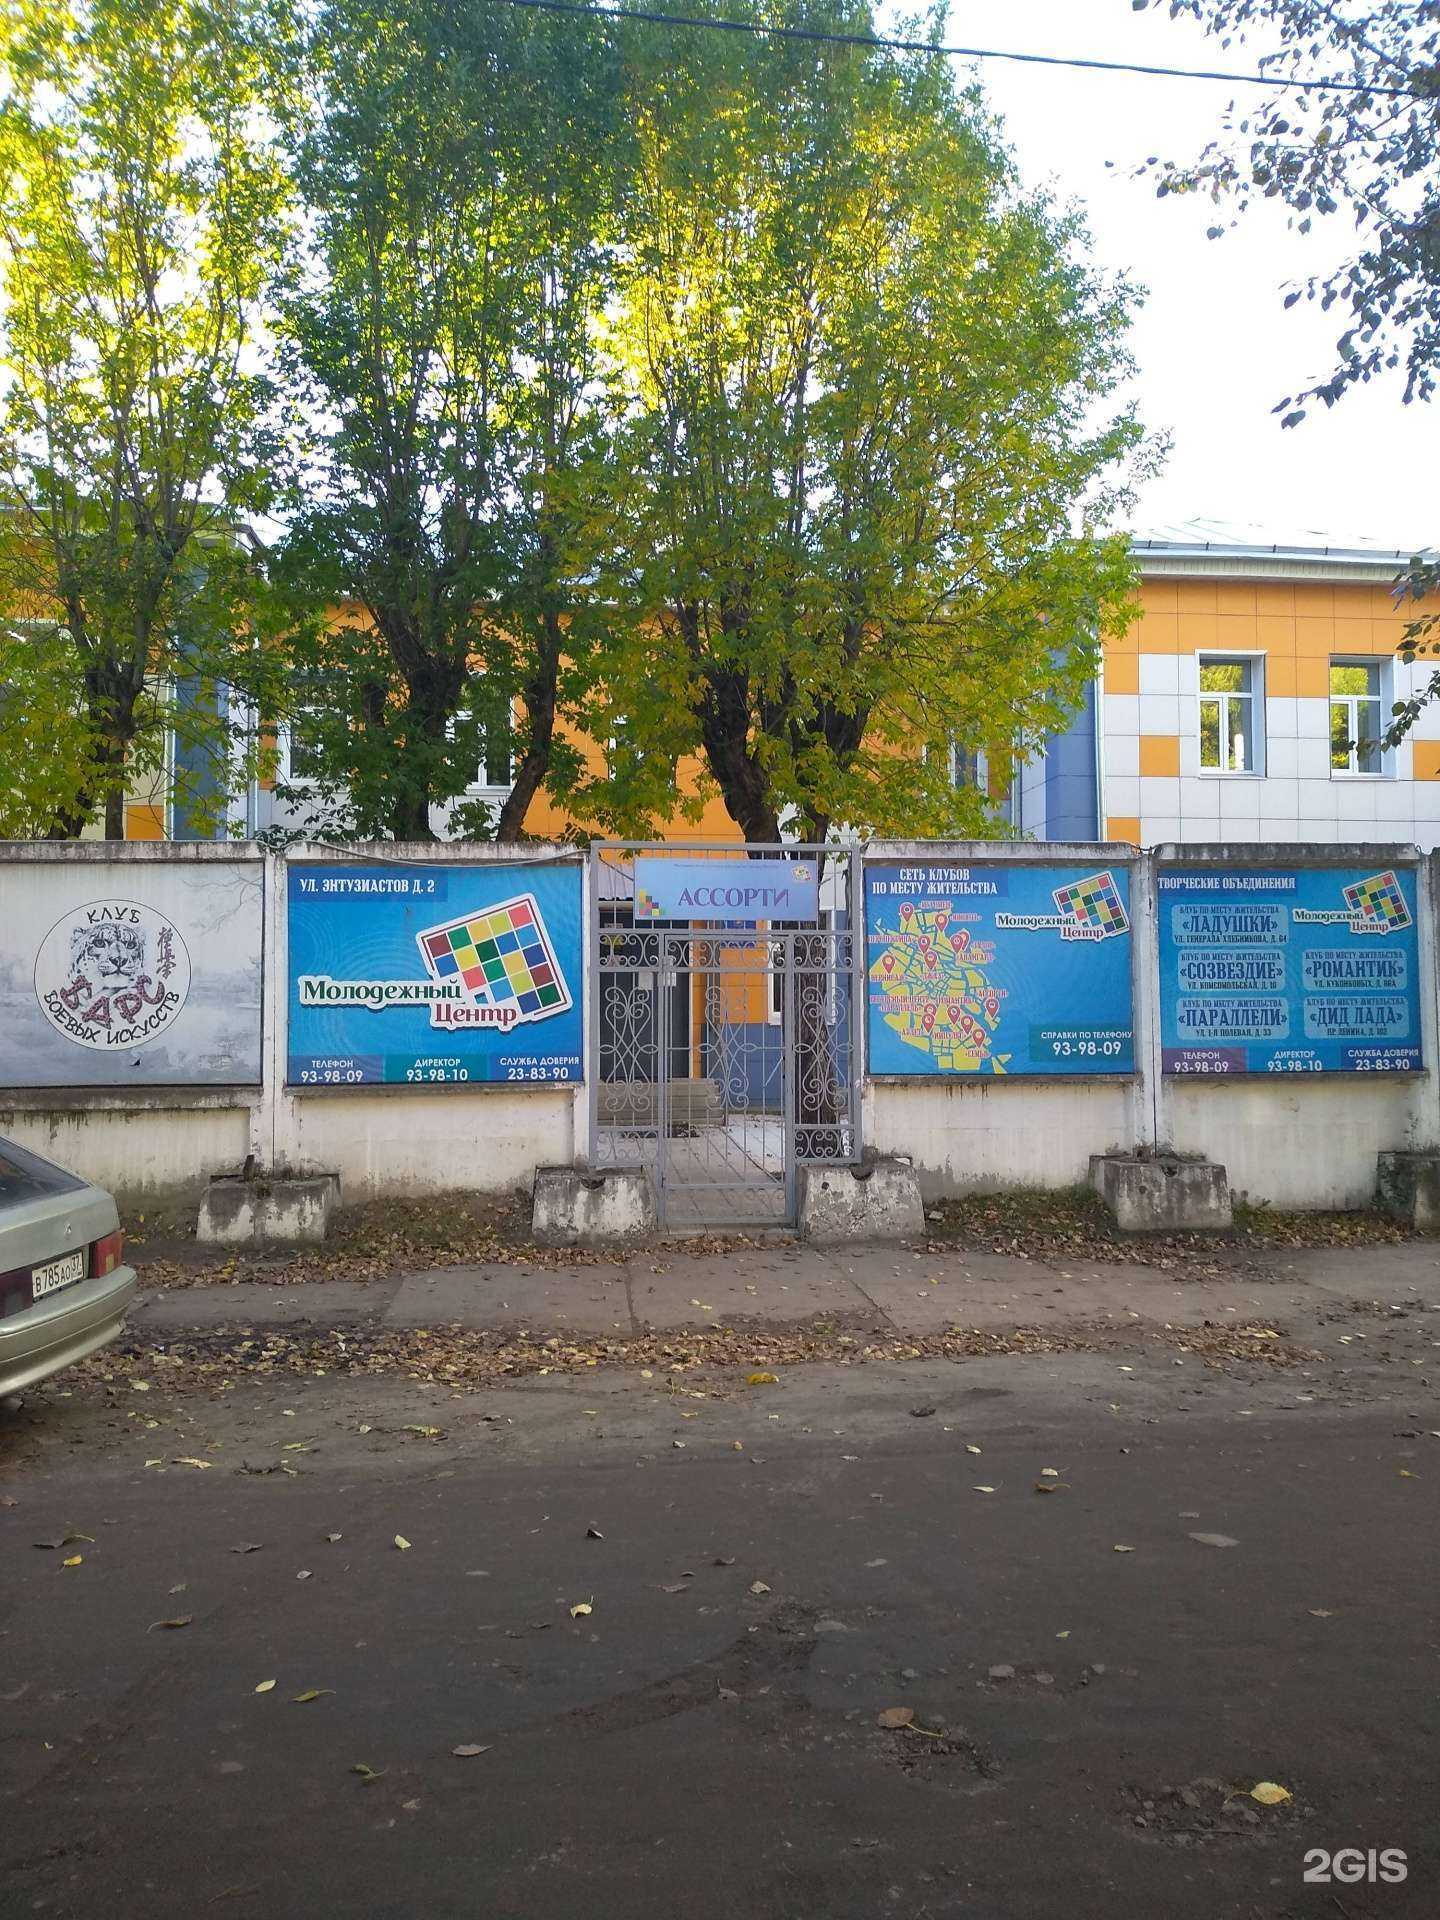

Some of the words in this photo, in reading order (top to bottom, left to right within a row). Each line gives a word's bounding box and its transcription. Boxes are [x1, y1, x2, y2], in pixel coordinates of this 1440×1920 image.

[899, 868, 926, 882] СЕТЬ
[929, 868, 970, 881] КЛУБОВ
[299, 879, 319, 894] УЛ.
[322, 878, 409, 893] ЭНТУЗИАСТОВ
[412, 878, 424, 894] Д.
[427, 878, 435, 893] 2
[872, 882, 887, 896] ПО
[889, 882, 924, 895] МЕСТУ
[926, 881, 998, 895] ЖИТЕЛЬСТВА
[1158, 877, 1220, 889] ТВОРЧЕСКИЕ
[1222, 877, 1296, 891] ОБЪЕДИНЕНИЯ
[678, 887, 790, 908] АССОРТИ
[86, 906, 142, 925] КЛУБ
[998, 914, 1077, 929] Молодежный
[1294, 910, 1363, 924] Молодежный
[1182, 915, 1278, 935] «ЛАДУШКИ»
[1352, 921, 1389, 934] Центр
[1062, 927, 1105, 941] Центр
[1180, 961, 1283, 981] «СОЗВЕЗДИЕ»
[1305, 961, 1404, 978] «РОМАНТИК»
[304, 978, 462, 1003] Молодежный
[60, 974, 166, 1030] БАРС
[44, 990, 101, 1043] БОЕВЫХ
[107, 991, 180, 1045] ИСКУССТВ
[434, 1003, 517, 1026] Центр
[1179, 1008, 1287, 1026] «ПАРАЛЛЕЛИ»
[1310, 1007, 1349, 1027] «ДИД
[1355, 1006, 1404, 1026] ЛАДА»
[1041, 1031, 1078, 1039] СПРАВКИ
[1079, 1031, 1091, 1039] ПО
[1093, 1031, 1132, 1040] ТЕЛЕФОНУ
[1052, 1042, 1122, 1056] 93-98-09
[1183, 1052, 1220, 1060] ТЕЛЕФОН
[1274, 1051, 1316, 1060] ДИРЕКТОР
[1348, 1049, 1382, 1057] СЛУЖБА
[1383, 1049, 1419, 1057] ДОВЕРИЯ
[311, 1059, 354, 1069] ТЕЛЕФОН
[414, 1058, 461, 1068] ДИРЕКТОР
[500, 1056, 538, 1067] СЛУЖБА
[539, 1056, 580, 1067] ДОВЕРИЯ
[1174, 1062, 1229, 1073] 93-98-09
[1267, 1061, 1323, 1071] 93-98-10
[1355, 1059, 1410, 1070] 23-83-90
[301, 1070, 363, 1083] 93-98-09
[406, 1069, 468, 1082] 93-98-10
[508, 1067, 569, 1080] 23-83-90
